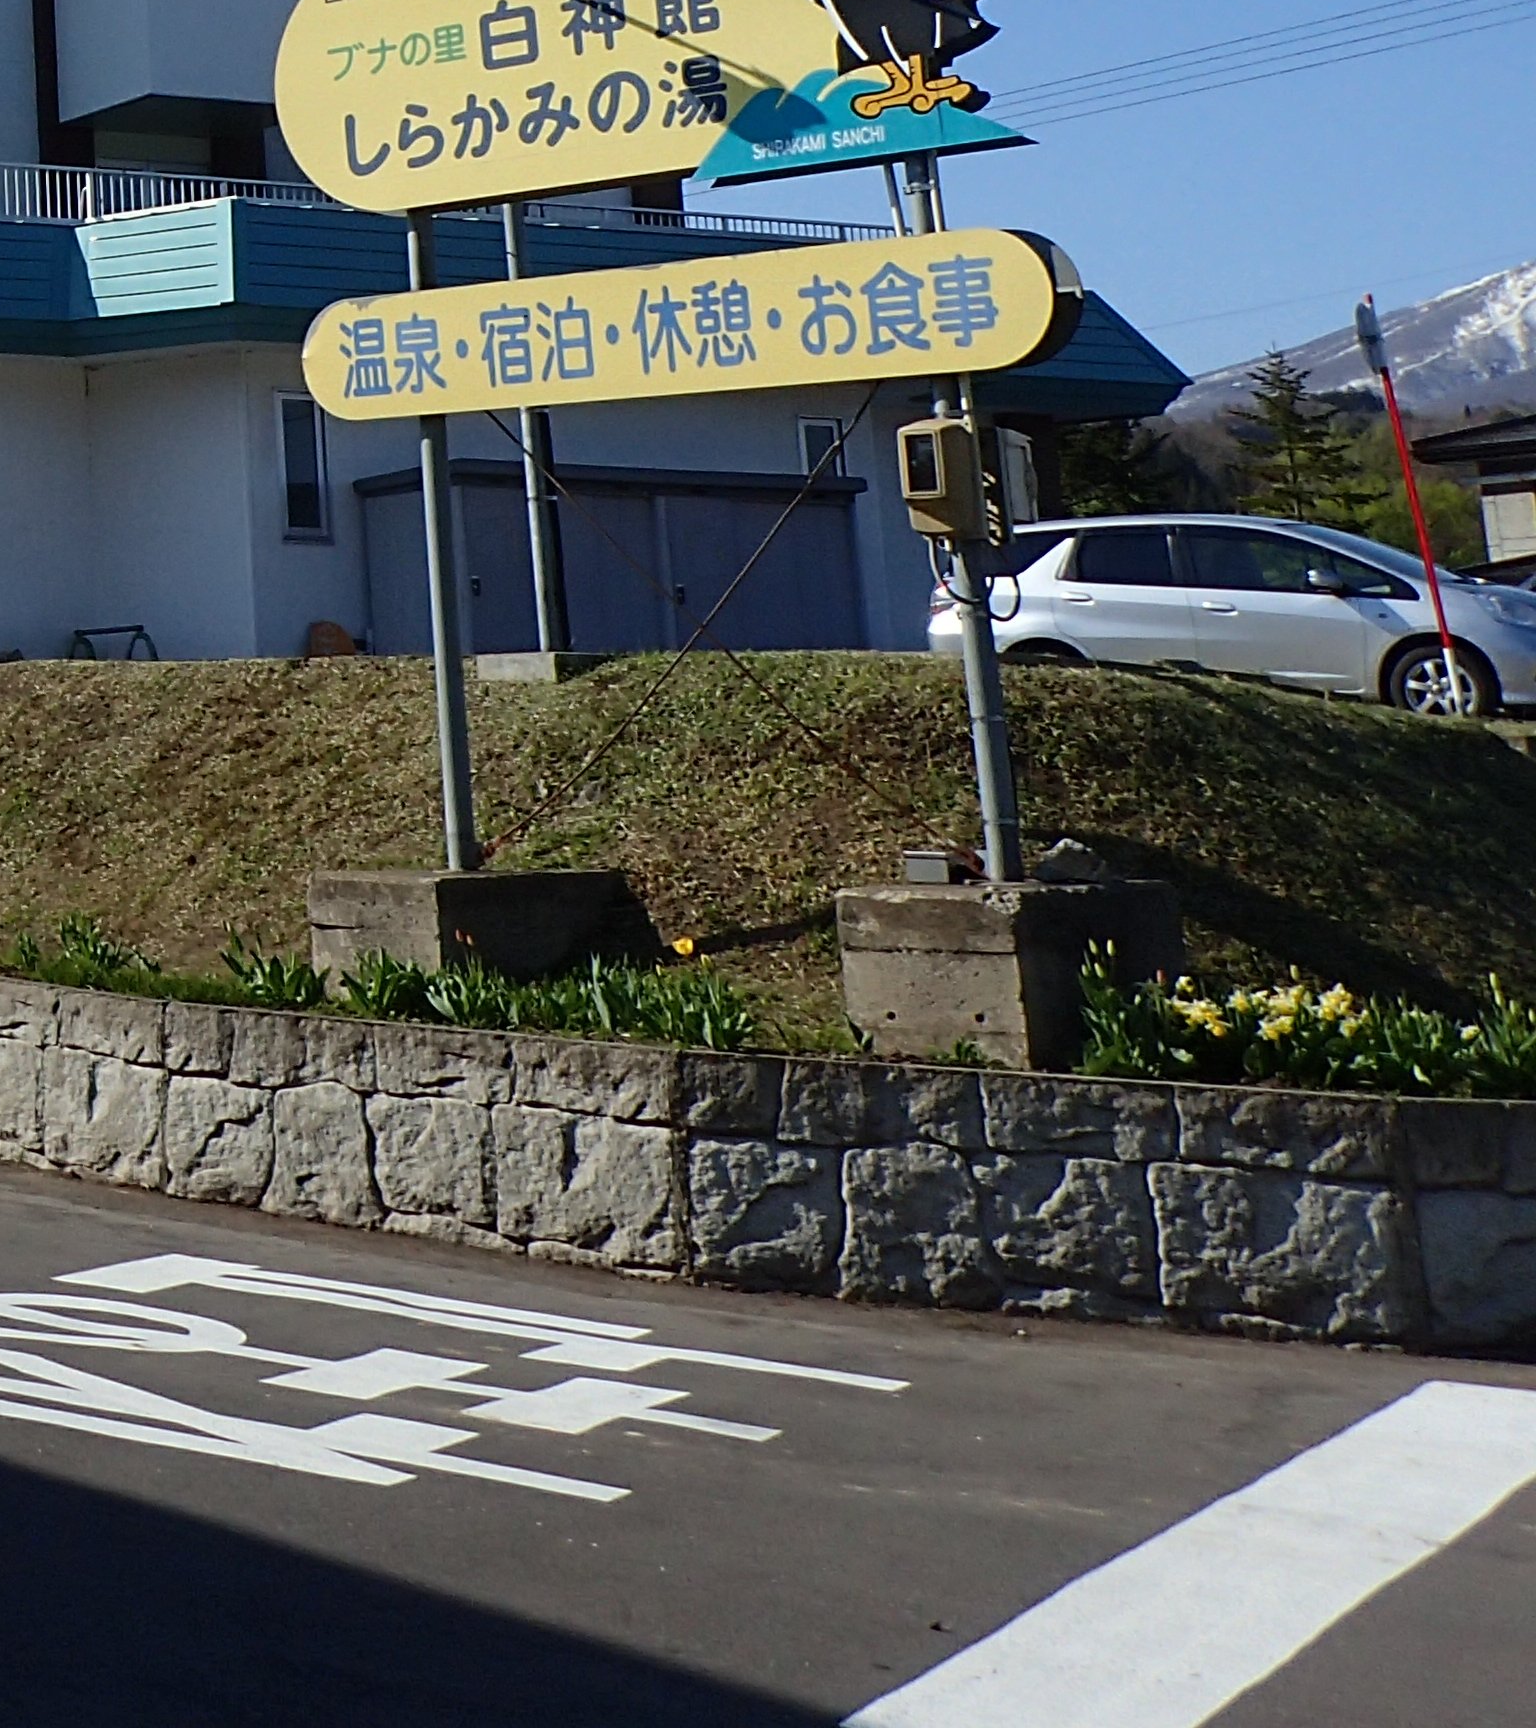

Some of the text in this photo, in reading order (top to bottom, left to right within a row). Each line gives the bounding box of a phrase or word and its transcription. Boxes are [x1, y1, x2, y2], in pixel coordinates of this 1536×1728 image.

[327, 23, 467, 81] ブナの里
[344, 54, 728, 176] しらかみの湯
[831, 125, 886, 149] SANCHI
